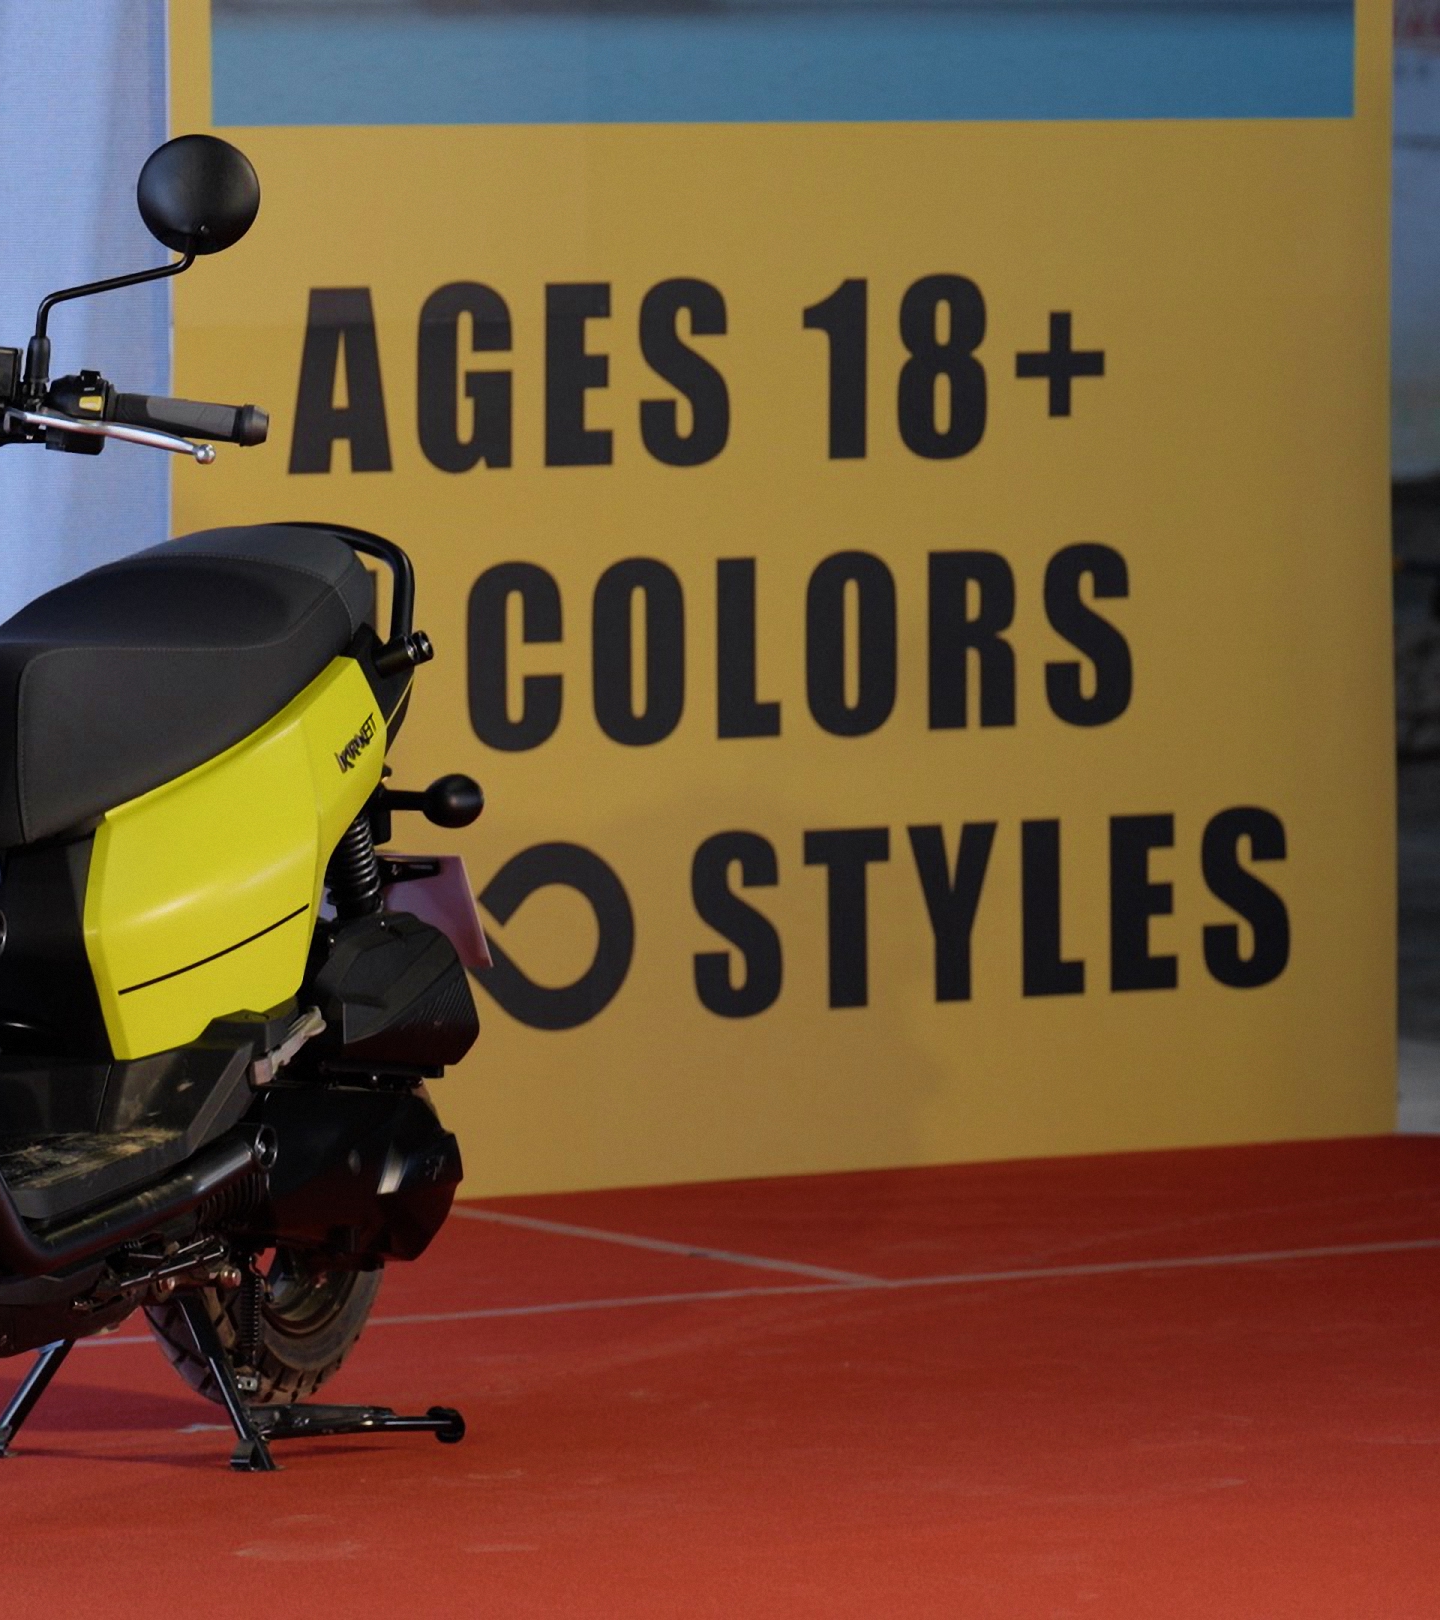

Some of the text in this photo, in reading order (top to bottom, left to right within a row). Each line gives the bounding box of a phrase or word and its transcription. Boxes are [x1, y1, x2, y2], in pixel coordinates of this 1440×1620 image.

[287, 272, 1106, 475] AGES 18+
[466, 541, 1134, 755] COLORS
[690, 804, 1293, 1021] STYLES
